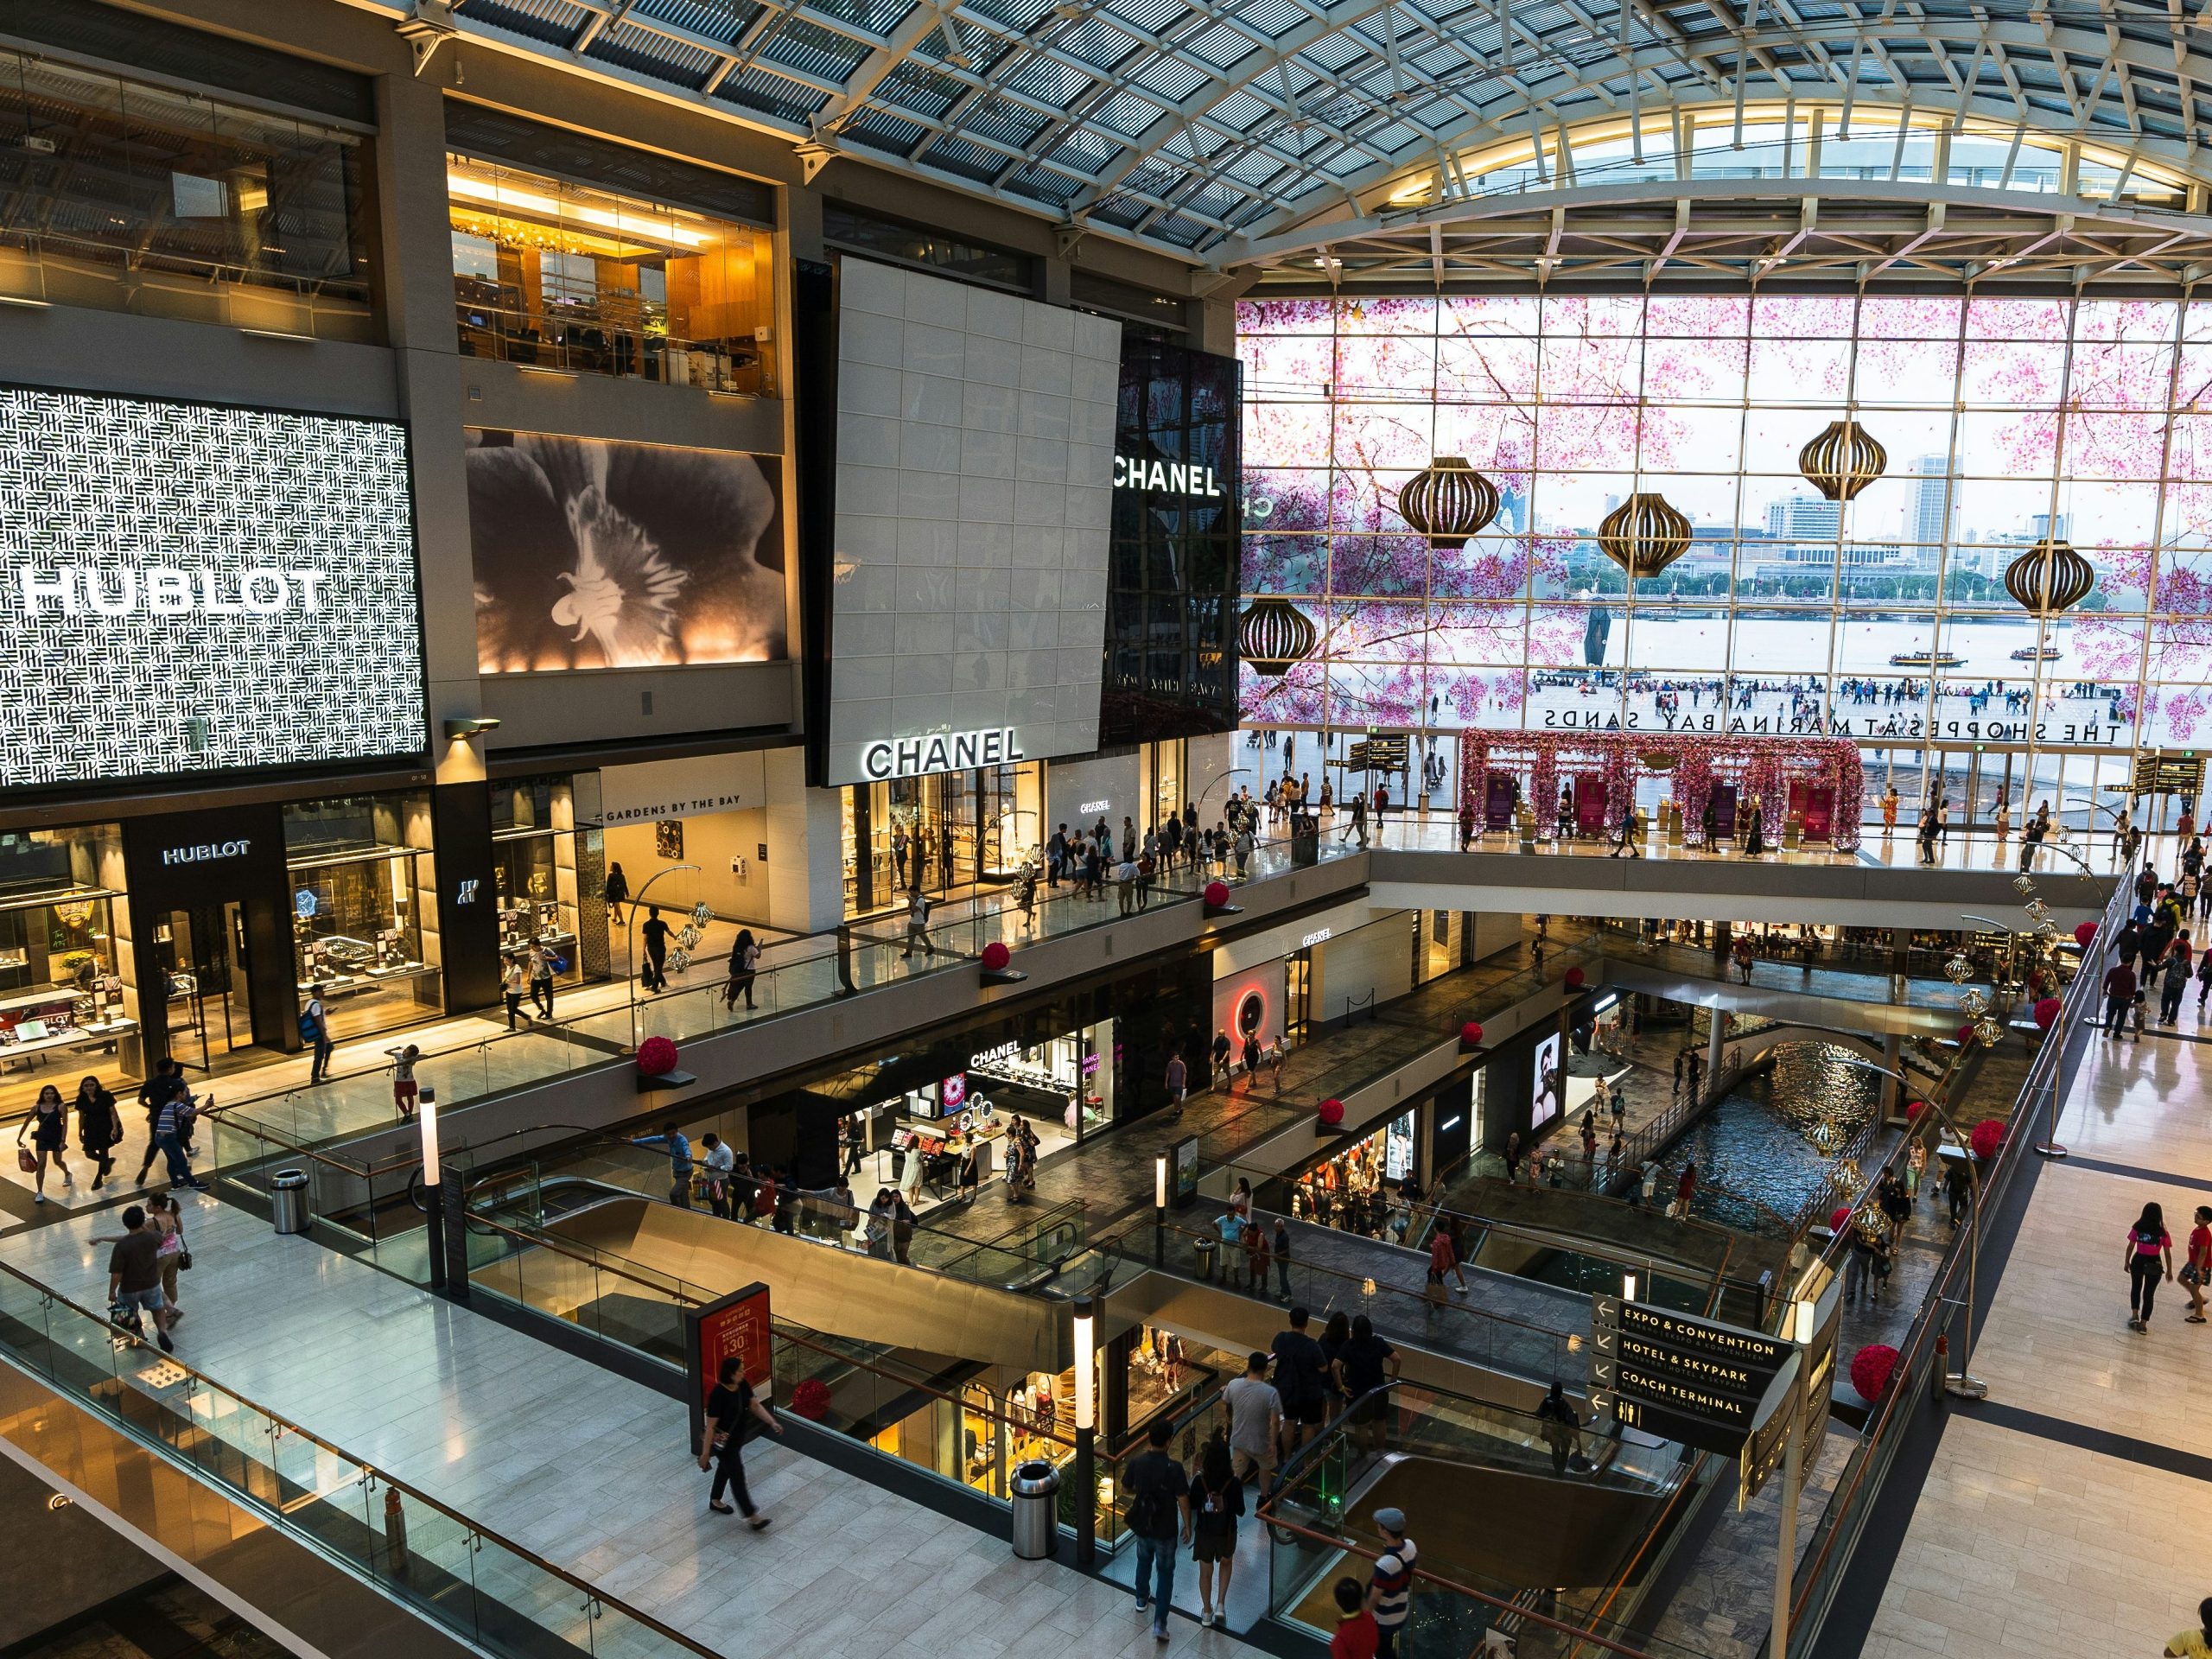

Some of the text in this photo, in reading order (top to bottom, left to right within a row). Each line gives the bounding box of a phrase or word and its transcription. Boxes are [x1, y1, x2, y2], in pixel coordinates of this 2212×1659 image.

[1113, 454, 1220, 497] CHANEL
[20, 565, 326, 617] HUBLOT
[866, 729, 1024, 779] CHANEL
[607, 805, 666, 821] GARDENS
[671, 802, 686, 812] BY
[691, 798, 714, 810] THE
[719, 795, 741, 806] BAY
[1080, 799, 1111, 814] CHANEL
[163, 840, 251, 865] HUBLOT
[1302, 927, 1332, 947] CHANEL
[970, 1039, 1021, 1068] CHANEL
[729, 1335, 745, 1352] 30
[1624, 1309, 1659, 1326] EXPO
[1663, 1320, 1672, 1330] &
[1677, 1324, 1775, 1356] CONVENTION
[1624, 1341, 1666, 1362] HOTEL
[1670, 1355, 1679, 1364] &
[1683, 1358, 1748, 1382] SKYPARK
[1621, 1370, 1743, 1414] COACH TERMINAL
